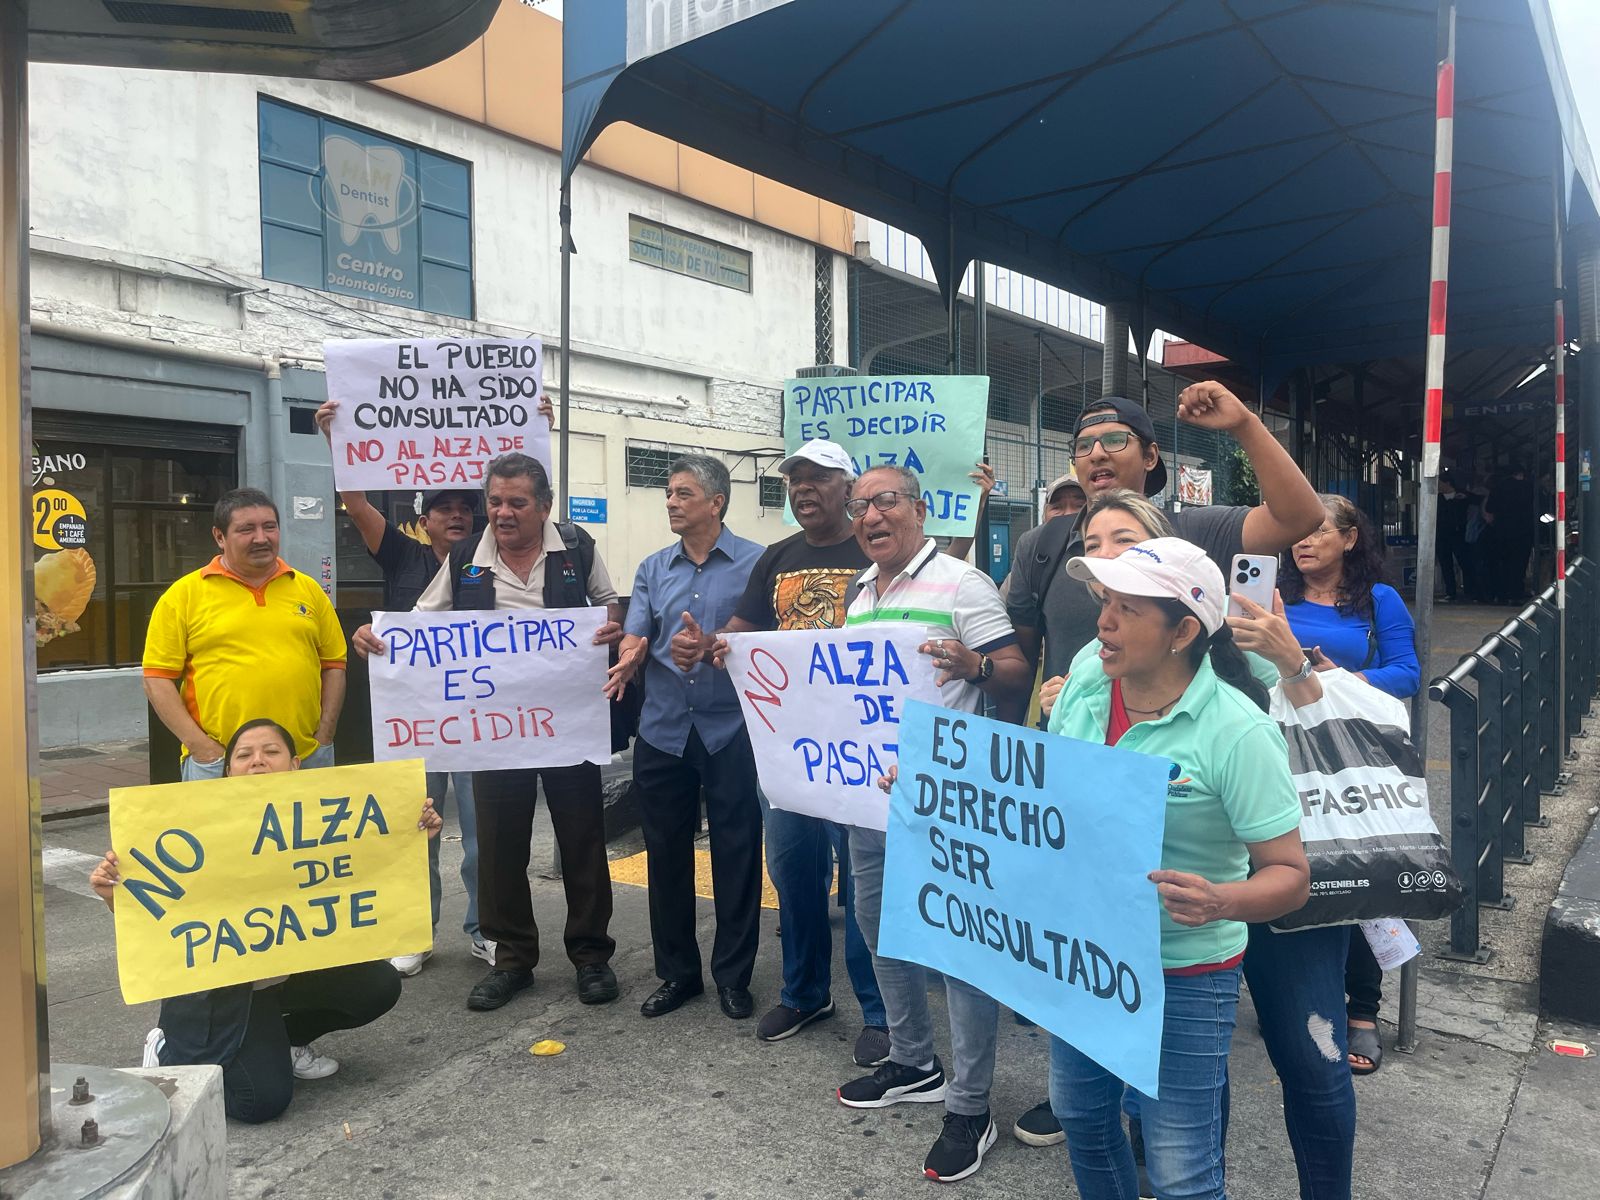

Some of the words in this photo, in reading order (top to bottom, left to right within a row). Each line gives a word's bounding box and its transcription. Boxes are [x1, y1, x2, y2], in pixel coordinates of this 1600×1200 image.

[341, 184, 389, 207] Dentist
[337, 253, 403, 281] Centro
[687, 255, 701, 272] DE
[704, 259, 717, 276] TU
[327, 273, 414, 299] Odontológico
[398, 344, 428, 369] EL
[437, 342, 537, 369] PUEBLO
[379, 375, 419, 401] NO
[432, 375, 466, 399] HA
[793, 381, 935, 417] PARTICIPAR
[354, 402, 528, 430] CONSULTADO
[801, 421, 831, 441] ES
[347, 439, 384, 465] NO
[398, 440, 424, 460] AL
[433, 436, 492, 458] ALZA
[497, 436, 524, 451] DE
[387, 459, 495, 485] PASAJ
[922, 489, 972, 521] AJE
[69, 530, 84, 538] CAFÉ
[444, 665, 495, 701] ES
[744, 648, 789, 733] NO
[809, 640, 910, 686] ALZA
[854, 694, 900, 725] DE
[932, 716, 967, 770] ES
[990, 732, 1045, 789] UN
[914, 773, 1065, 850] DERECHO
[123, 828, 205, 921] NO
[251, 794, 389, 855] ALZA
[293, 854, 353, 889] DE
[929, 826, 994, 890] SER
[170, 890, 378, 968] PASAJE
[918, 883, 1141, 1014] CONSULTADO
